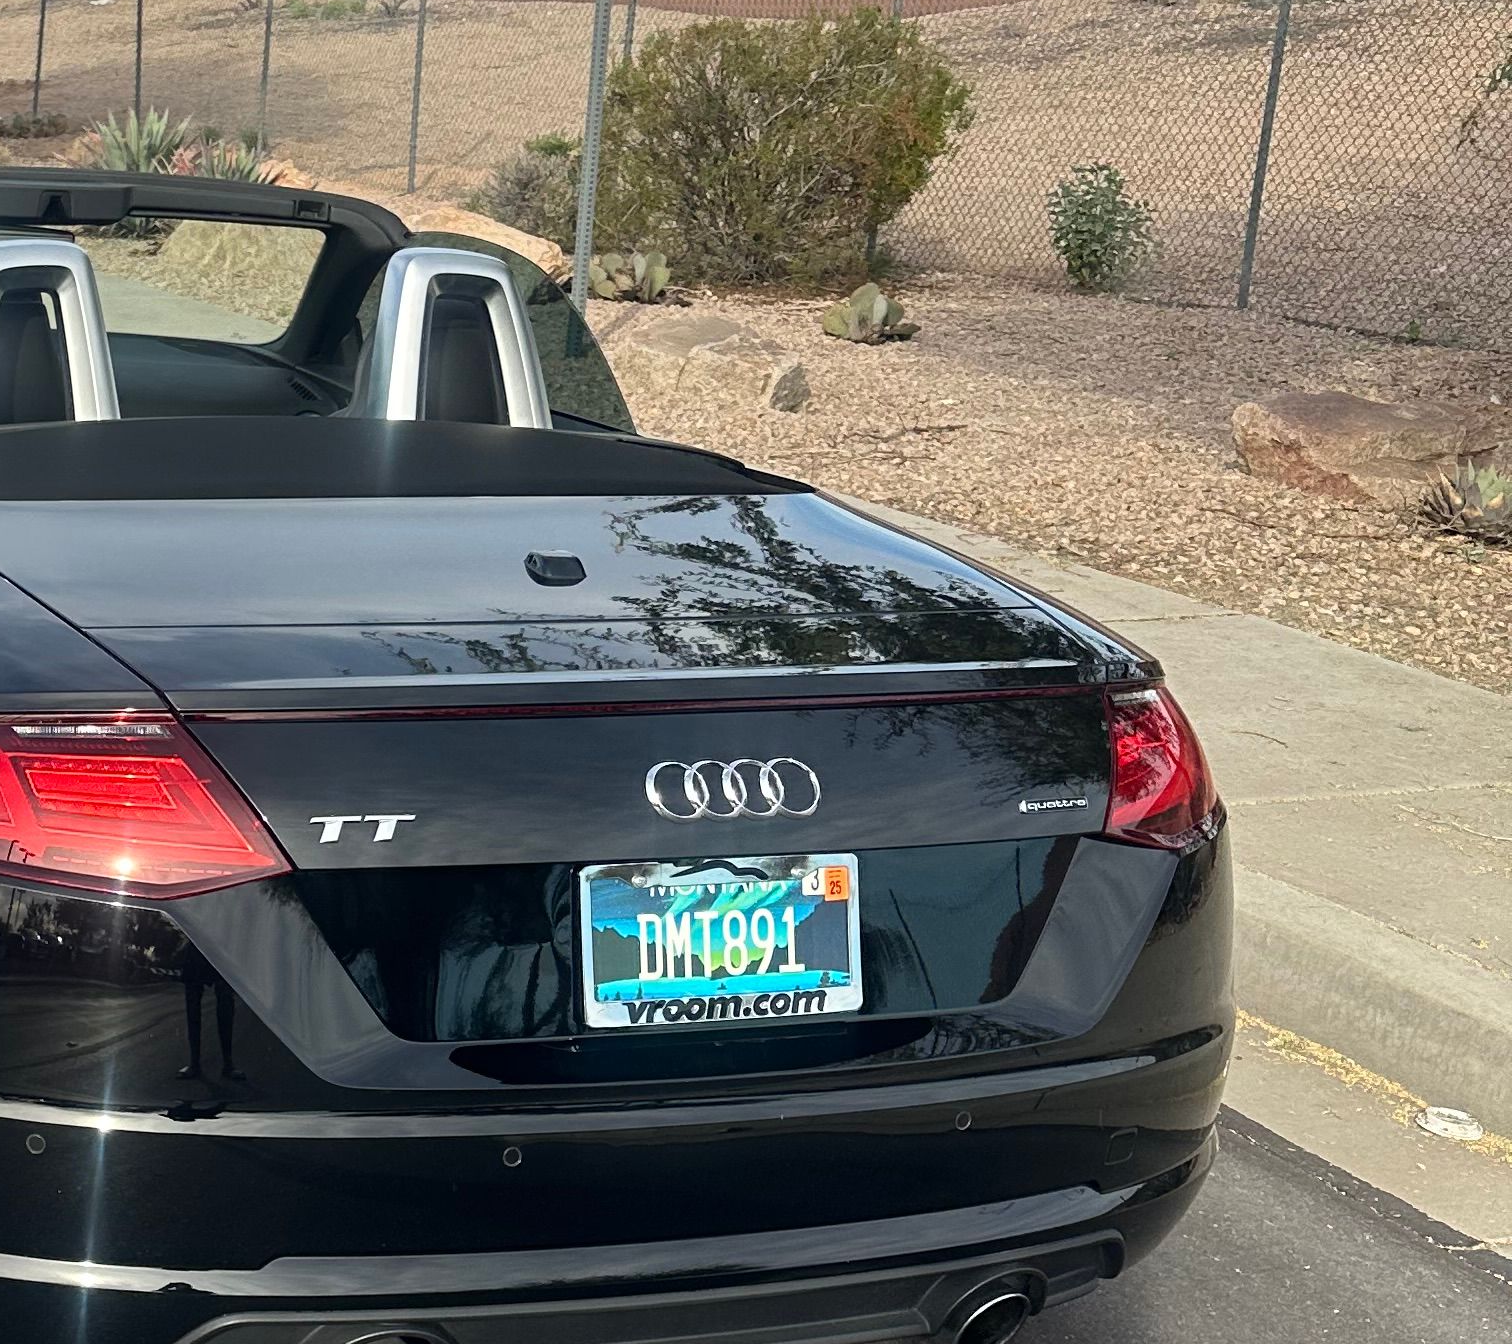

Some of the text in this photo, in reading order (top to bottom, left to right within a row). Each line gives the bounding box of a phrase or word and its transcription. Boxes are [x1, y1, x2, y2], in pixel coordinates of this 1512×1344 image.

[1027, 799, 1086, 811] quattro
[310, 814, 416, 844] TT
[829, 880, 842, 895] 25
[637, 906, 806, 980] DMT891
[622, 989, 827, 1024] vroom.com
